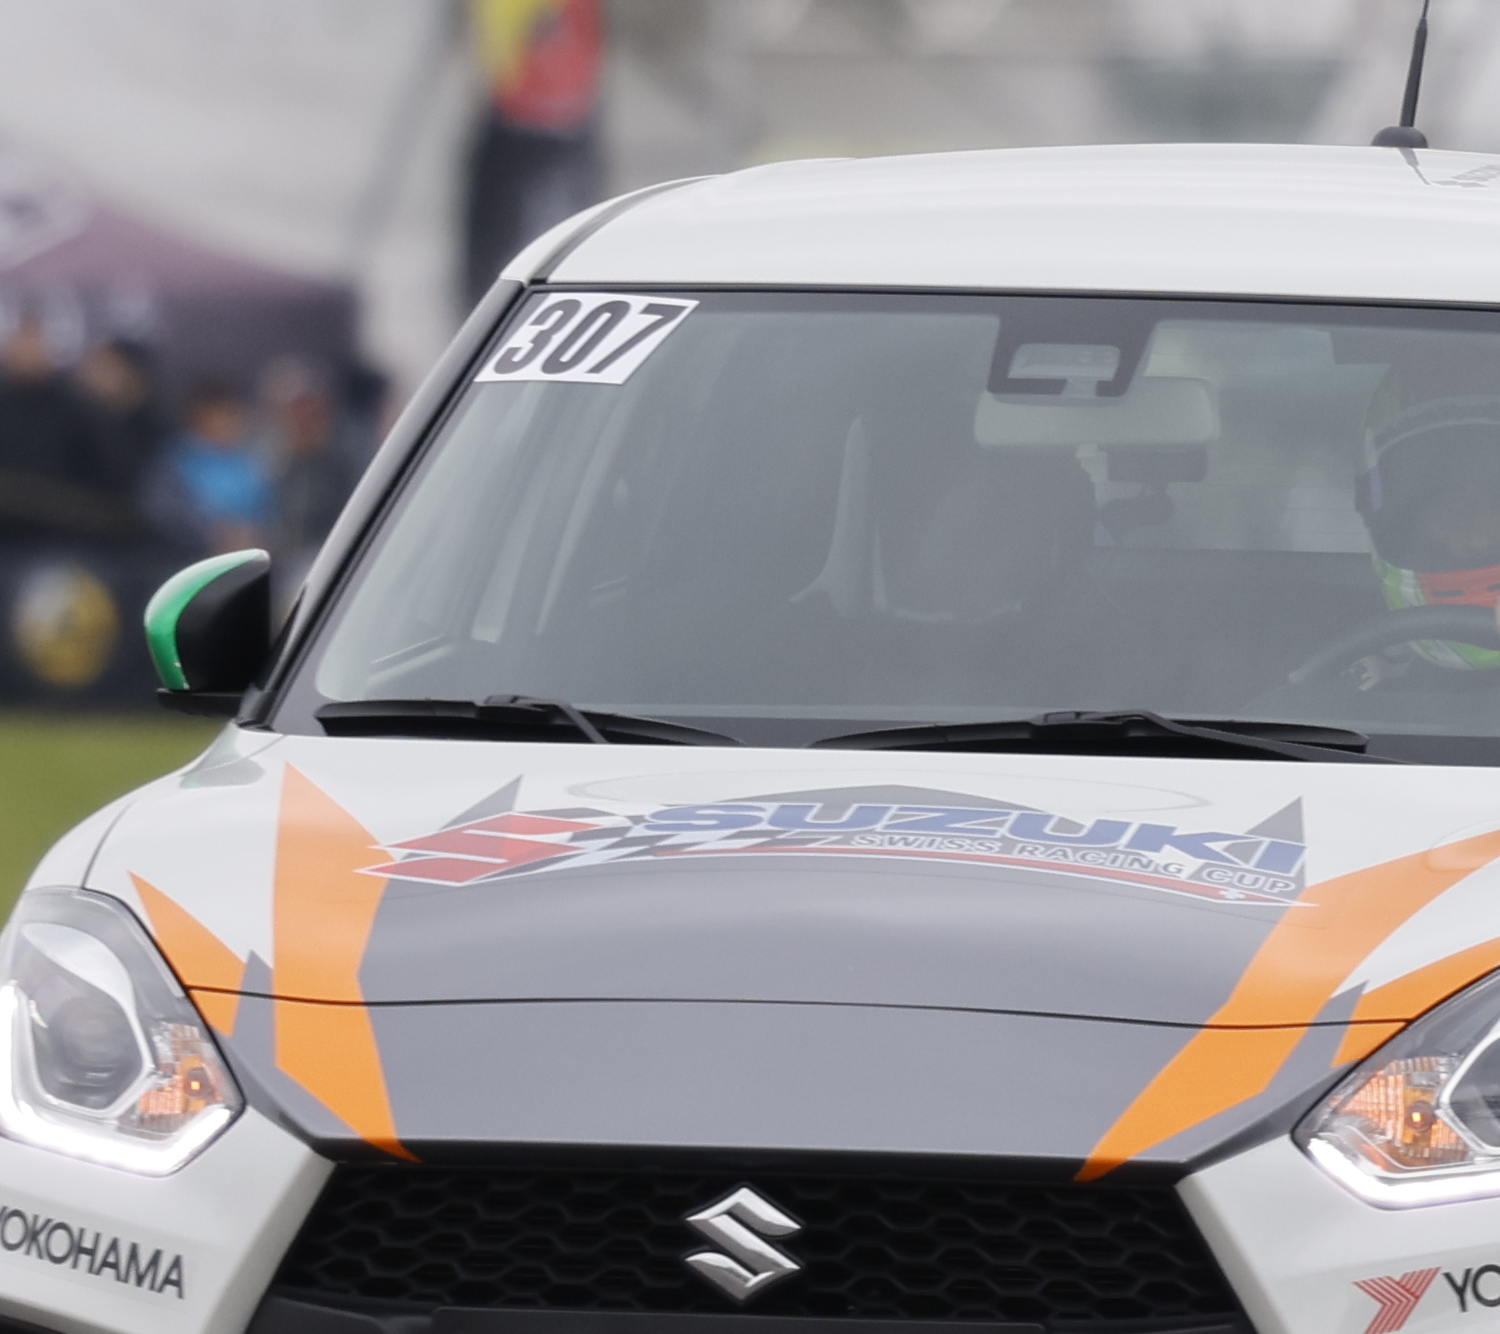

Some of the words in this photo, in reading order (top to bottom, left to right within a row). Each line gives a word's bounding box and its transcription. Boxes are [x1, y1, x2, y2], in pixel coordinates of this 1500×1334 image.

[493, 298, 689, 375] 307
[645, 802, 1308, 878] SUZUKI
[850, 832, 1004, 857] SWISS
[1013, 841, 1188, 878] RACING
[1202, 865, 1297, 897] CUP
